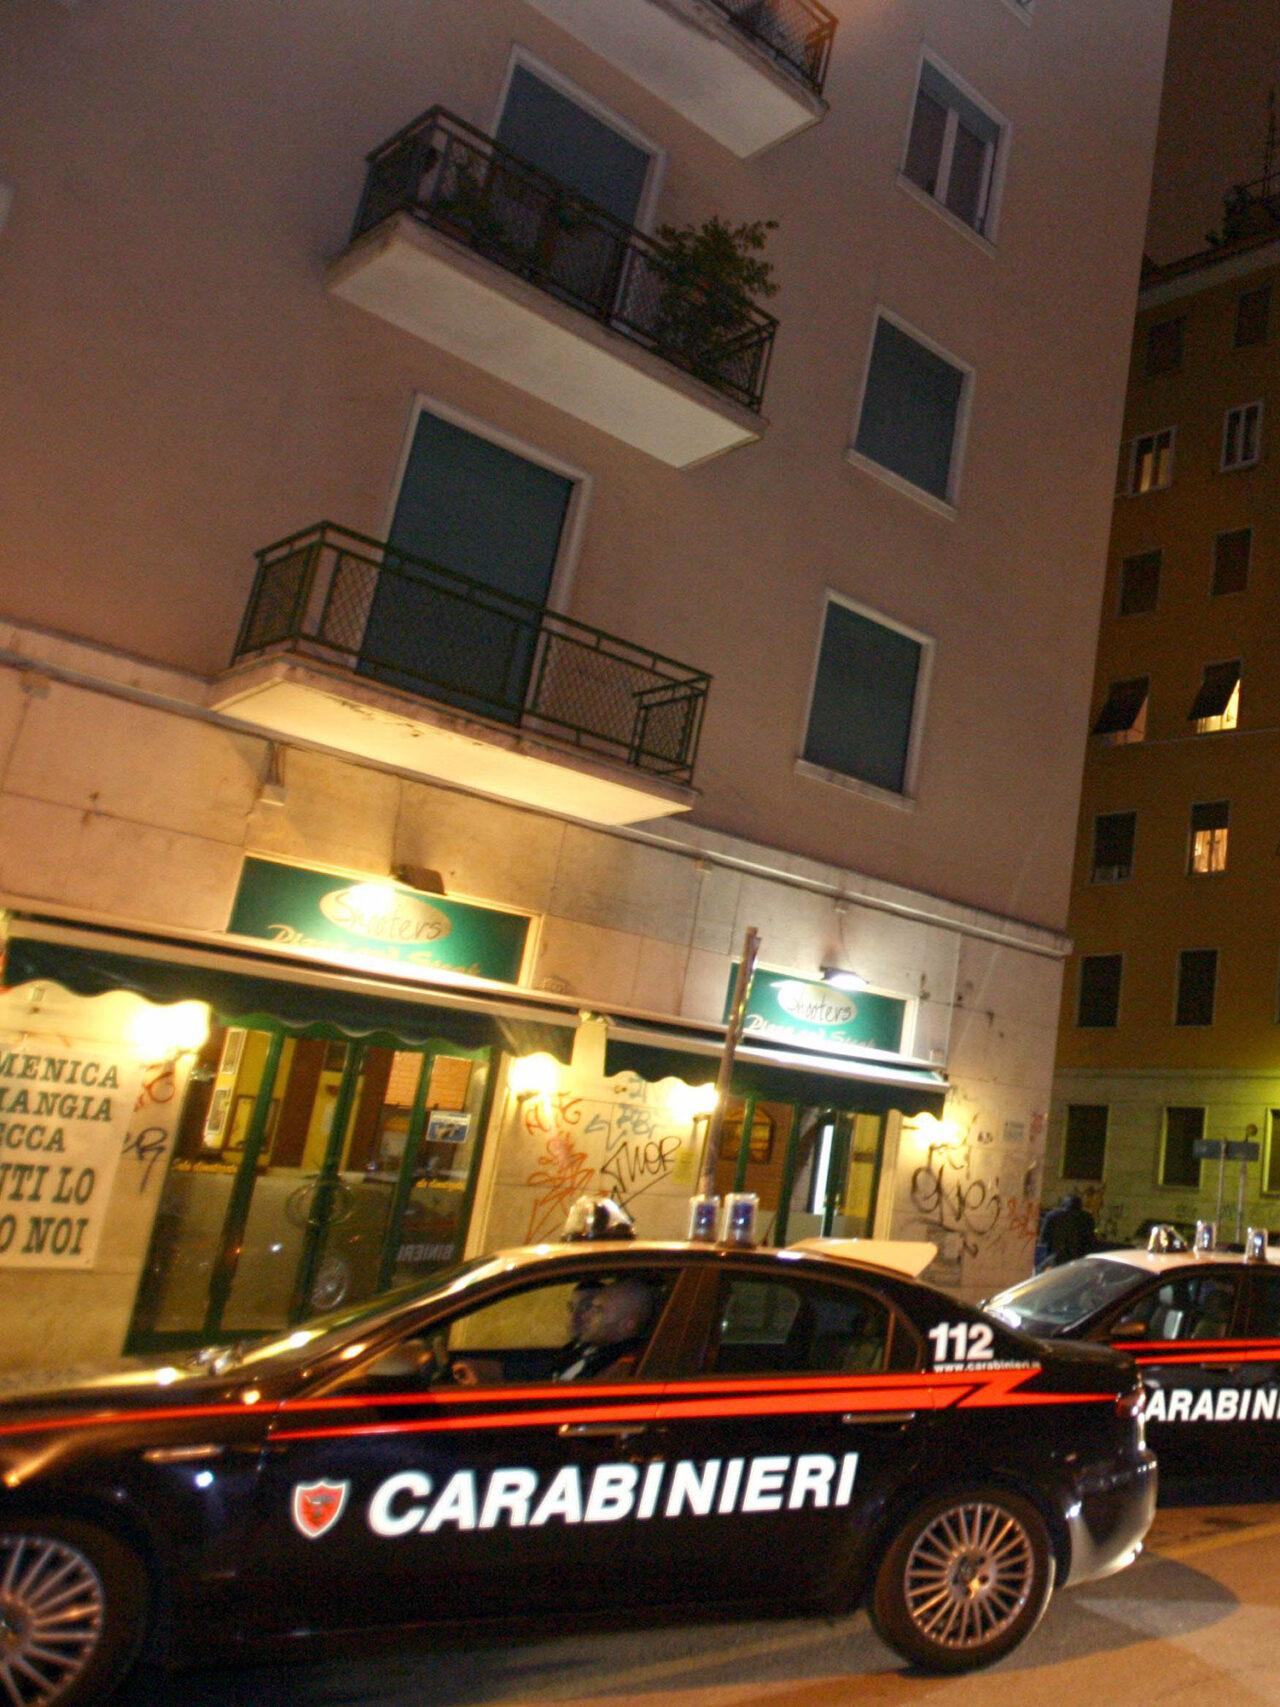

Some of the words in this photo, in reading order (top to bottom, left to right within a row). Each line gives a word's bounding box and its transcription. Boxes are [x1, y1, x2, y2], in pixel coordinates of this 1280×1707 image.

[0, 1122, 65, 1152] CCA
[52, 1167, 95, 1205] LO
[21, 1216, 89, 1256] NOI
[928, 1321, 994, 1361] 112
[367, 1452, 859, 1537] CARABINIERI
